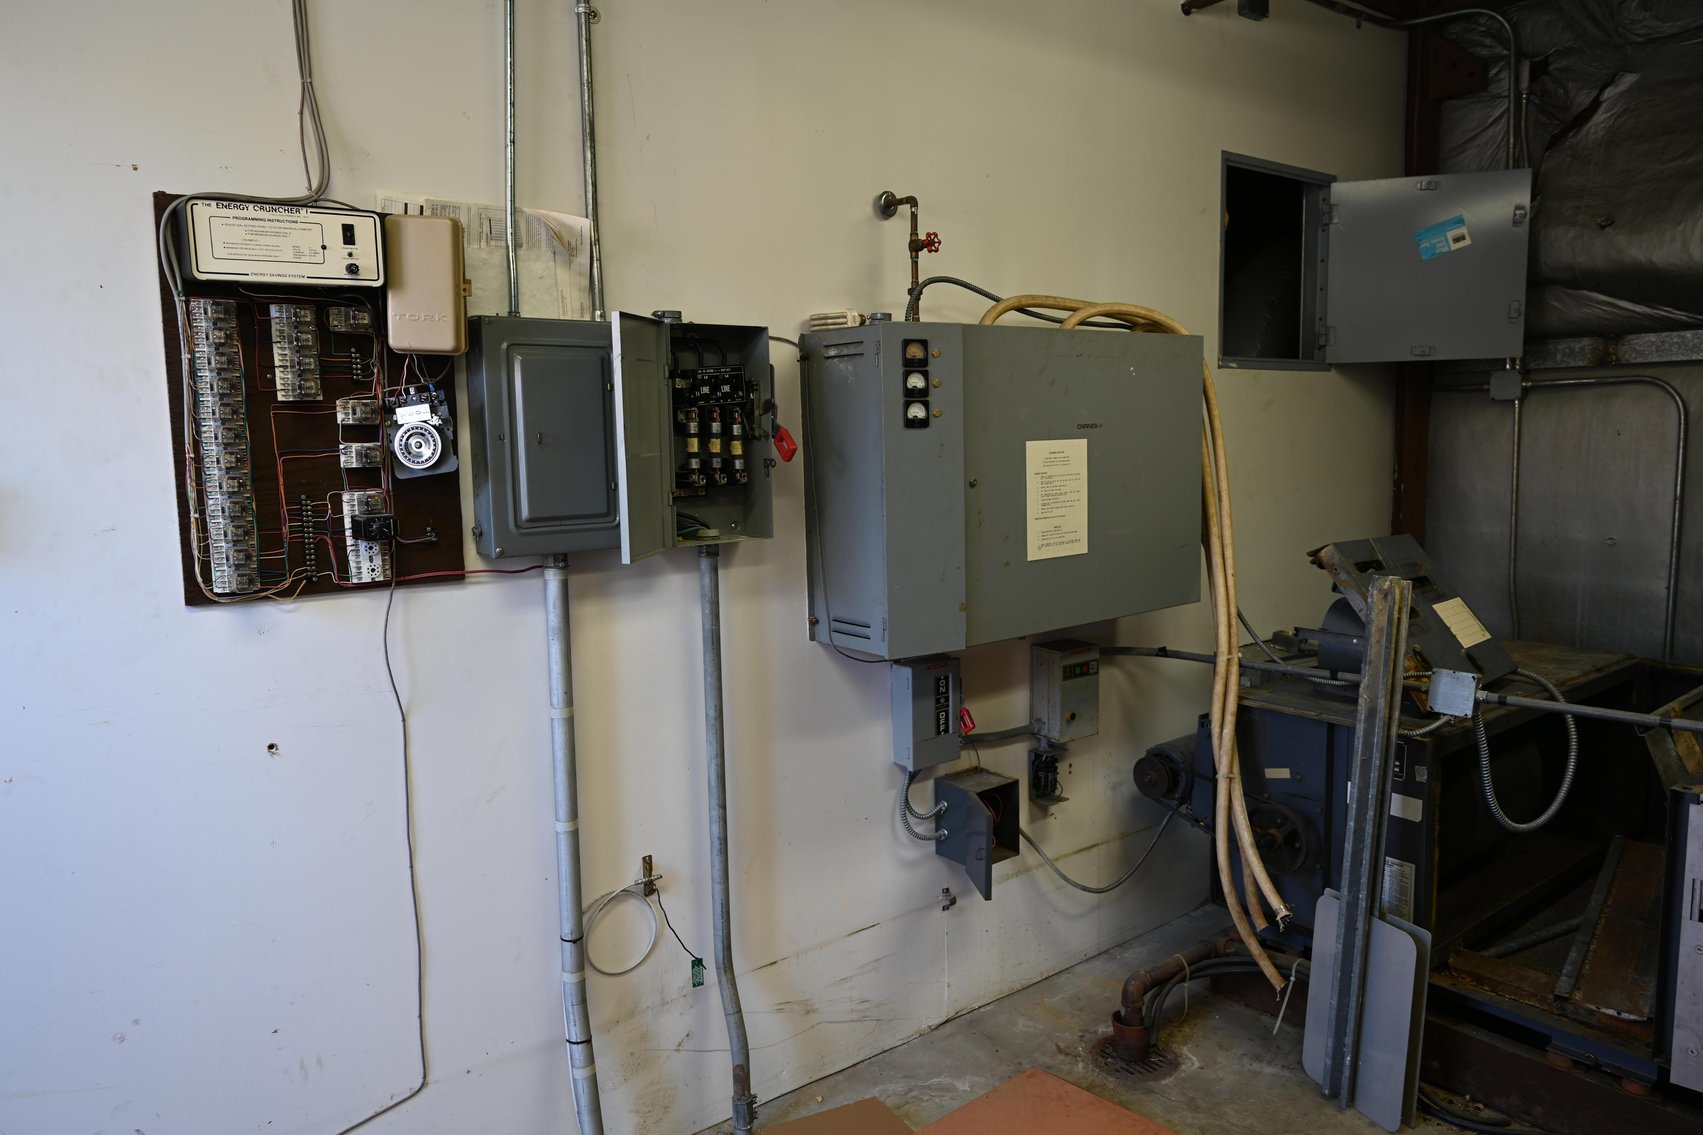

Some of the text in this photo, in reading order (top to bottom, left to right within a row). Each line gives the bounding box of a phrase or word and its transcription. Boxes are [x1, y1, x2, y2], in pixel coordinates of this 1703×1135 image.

[215, 202, 250, 212] ENERGY
[267, 217, 299, 225] INSTRUCTIONS
[392, 312, 449, 322] TORK
[939, 679, 946, 693] ON
